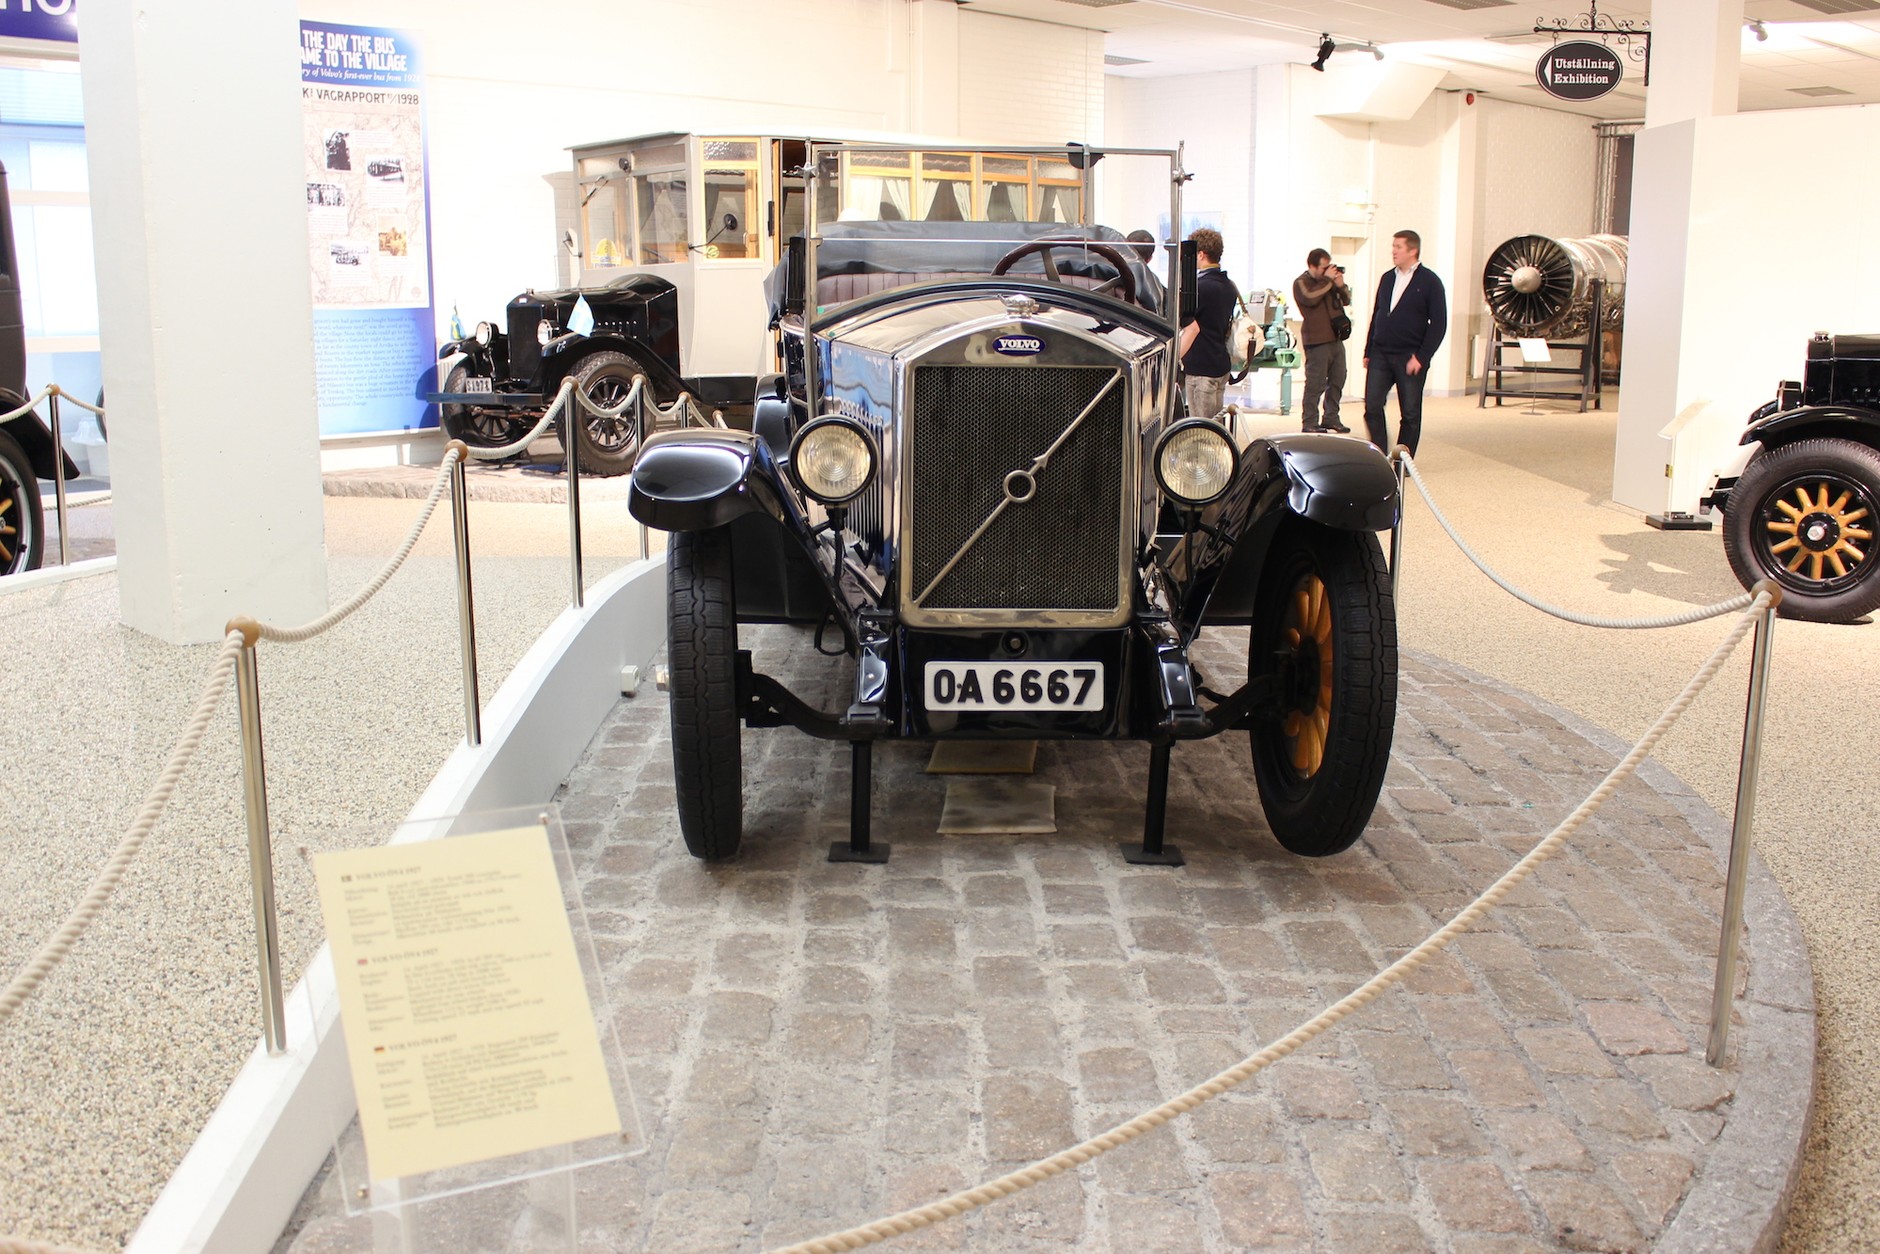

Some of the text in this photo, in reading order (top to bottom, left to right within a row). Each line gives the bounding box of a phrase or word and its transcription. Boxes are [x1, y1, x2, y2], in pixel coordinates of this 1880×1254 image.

[302, 30, 395, 54] THE DAY THE BUS
[324, 50, 339, 68] TO
[341, 51, 362, 69] THE
[365, 53, 408, 71] VILLAGE
[1554, 58, 1615, 70] Utställning
[312, 67, 320, 77] of
[321, 68, 342, 78] Volvo's
[343, 70, 372, 80] first-ever
[374, 72, 385, 81] bus
[386, 73, 401, 82] from
[1554, 73, 1608, 84] Exhibition
[999, 339, 1040, 348] VOLVO
[934, 669, 1096, 705] OA 6667
